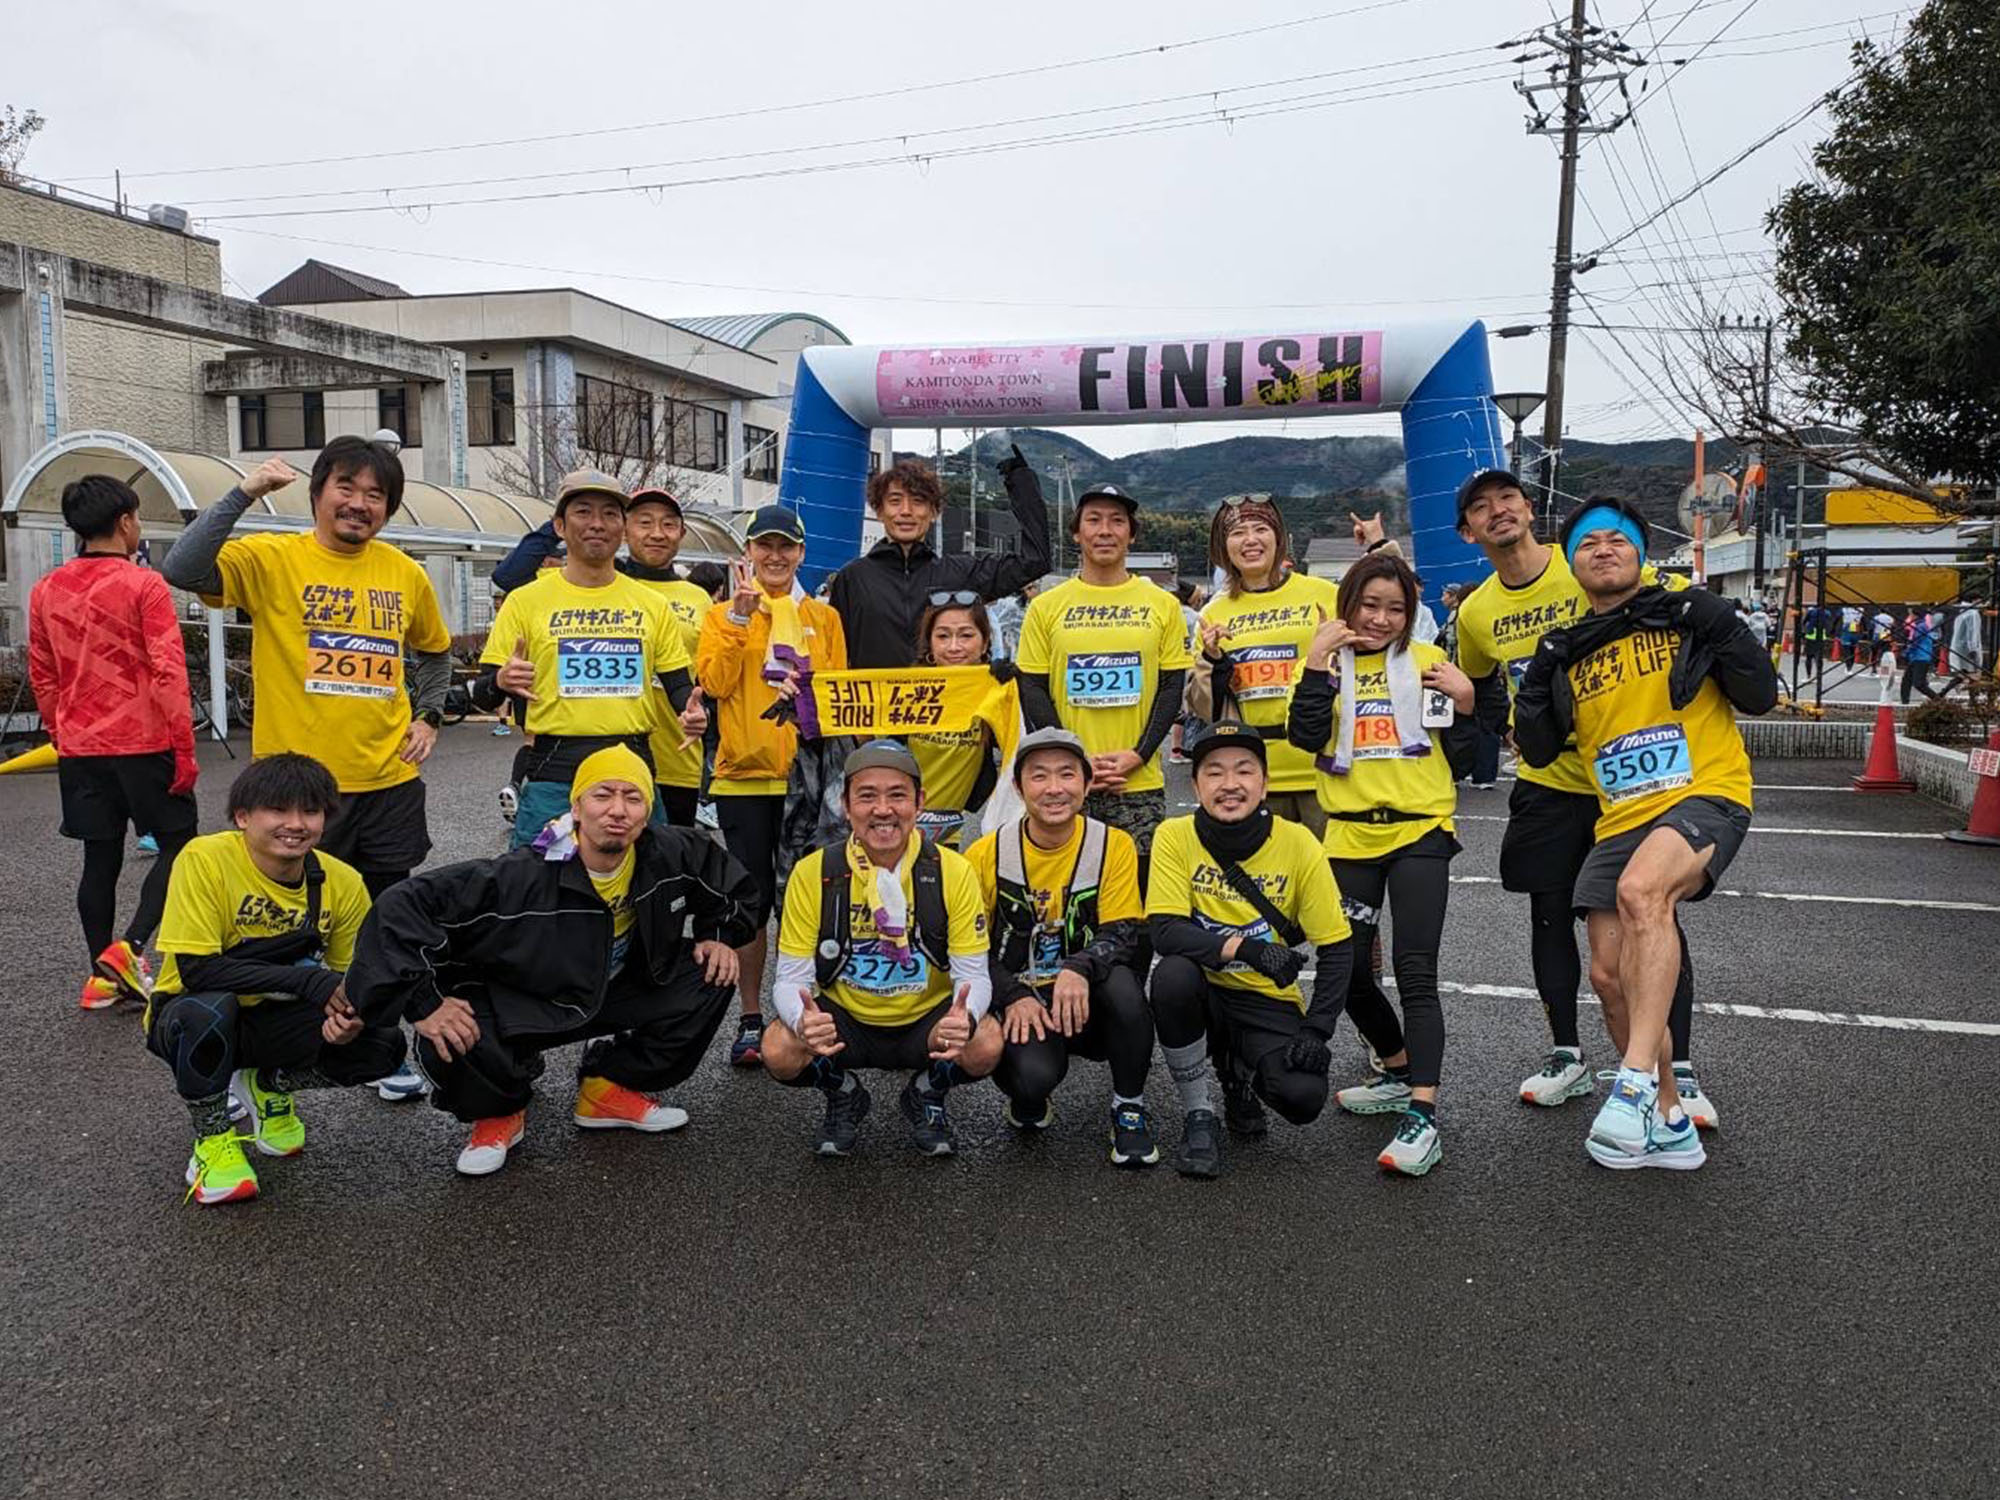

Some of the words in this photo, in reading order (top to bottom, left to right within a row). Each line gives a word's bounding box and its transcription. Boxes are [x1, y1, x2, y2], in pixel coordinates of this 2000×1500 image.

[928, 355, 986, 367] TANABE
[988, 353, 1023, 365] CITY
[905, 374, 994, 389] KAMITONDA
[999, 373, 1043, 386] TOWN
[1079, 335, 1364, 411] FINISH
[908, 396, 995, 411] SHIRAHAMA
[999, 395, 1043, 409] TOWN
[303, 585, 354, 603] ムラサキ
[368, 589, 403, 611] RIDE
[303, 603, 356, 623] スポーツ
[549, 608, 644, 628] ムラサキスポーツ
[1064, 605, 1151, 621] ムラサキスポーツ
[1227, 604, 1311, 631] ムラサキスポーツ
[1493, 597, 1578, 637] ムラサキスポーツ
[550, 627, 605, 636] MURASAKI
[608, 626, 646, 635] SPORTS
[1064, 621, 1113, 630] MURASAKI
[1115, 620, 1152, 629] SPORTS
[1632, 628, 1680, 654] RIDE
[313, 652, 393, 681] 2614
[565, 657, 638, 680] 5835
[1573, 645, 1621, 681] ムラサキ
[1072, 670, 1134, 692] 5921
[1578, 661, 1624, 698] スポーツ
[826, 679, 874, 704] LIFE
[889, 684, 946, 706] スポーツ
[831, 704, 875, 728] RIDE
[888, 705, 944, 726] ムラサキ
[1602, 745, 1679, 786] 5507
